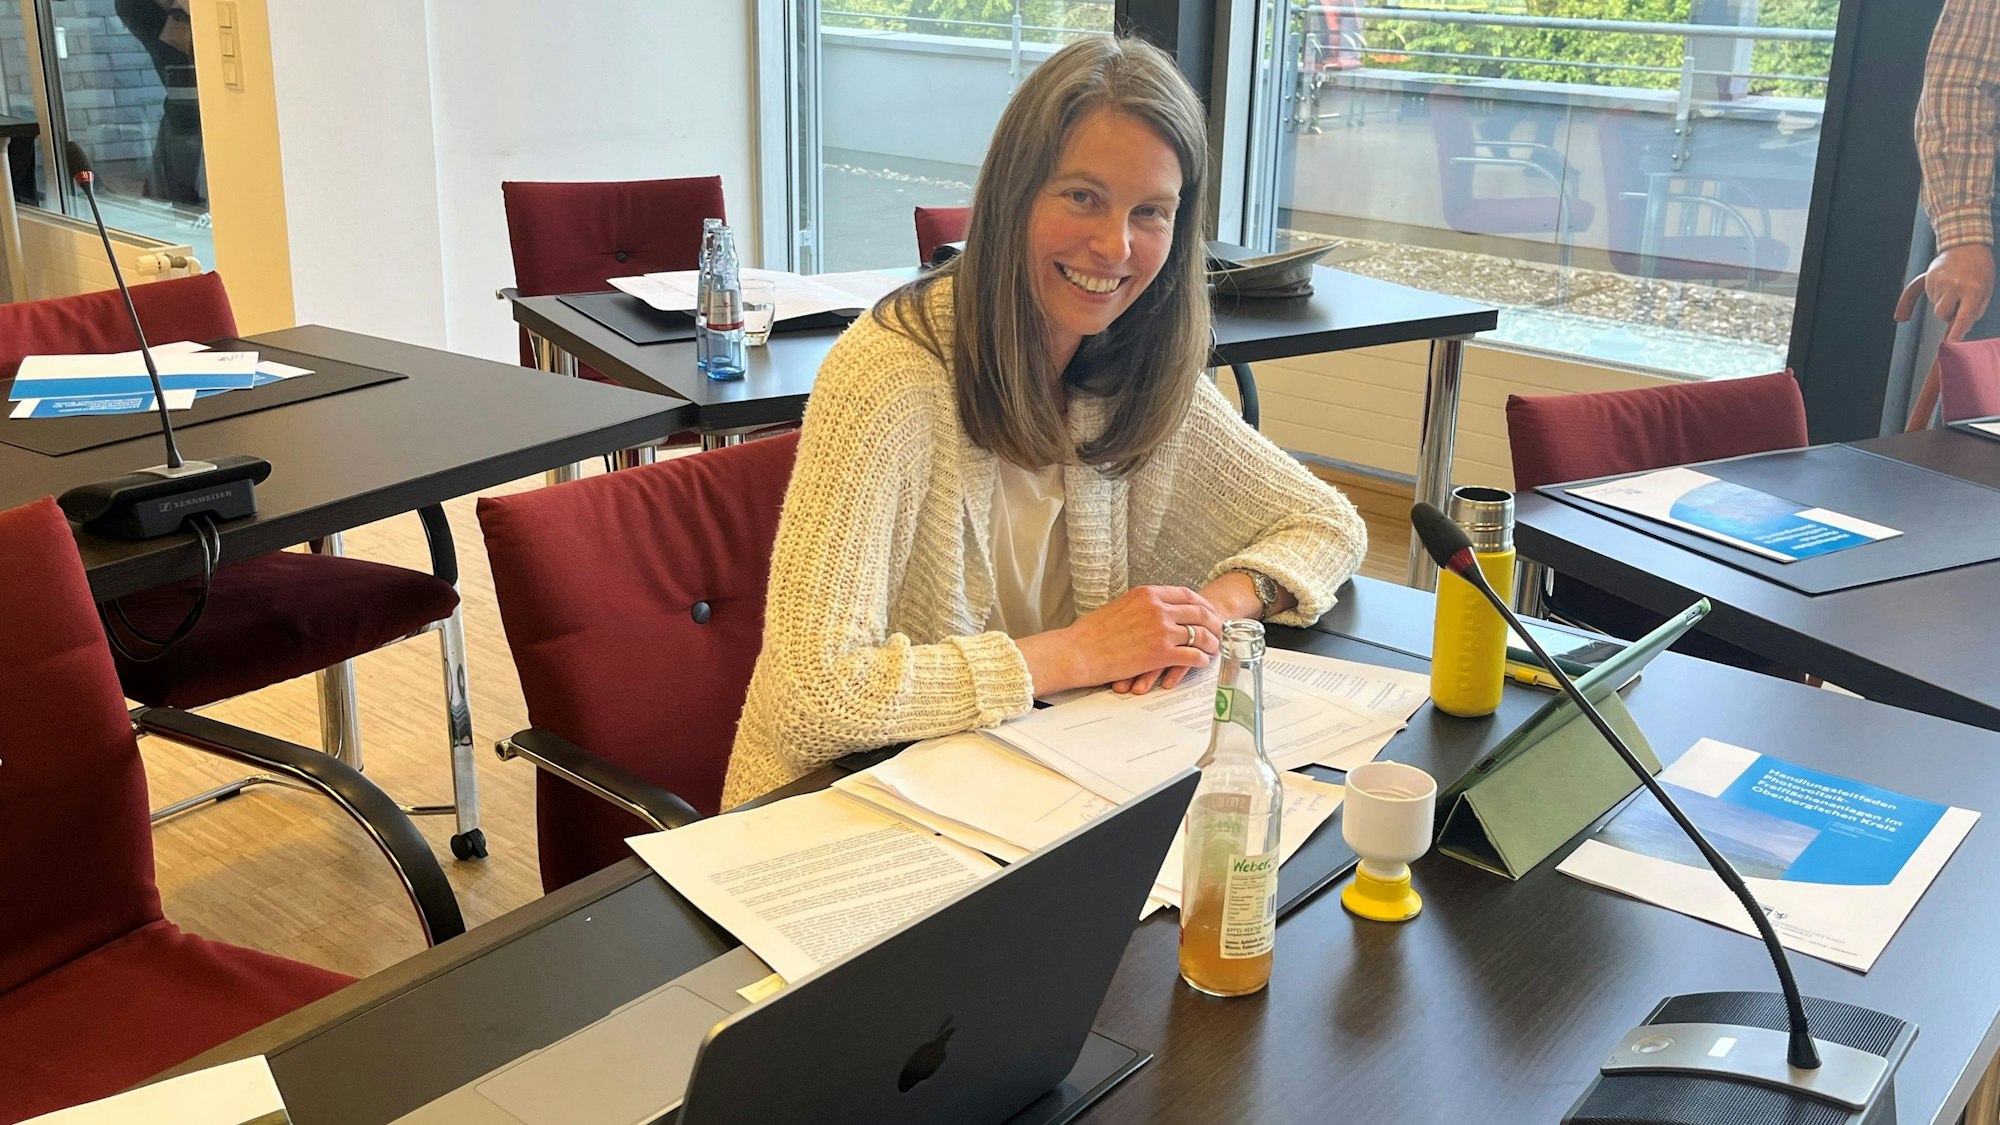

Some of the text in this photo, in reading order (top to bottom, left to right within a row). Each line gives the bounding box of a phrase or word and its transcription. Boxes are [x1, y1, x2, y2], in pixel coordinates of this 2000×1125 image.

[174, 490, 233, 509] SENNHEISER
[1751, 785, 1857, 822] Oberbergischen
[1859, 817, 1897, 833] Kreis
[1756, 780, 1903, 827] Freiflächenanlagen im
[1762, 774, 1849, 804] Photovoltaik-
[1768, 769, 1897, 811] Handlungsleitfaden
